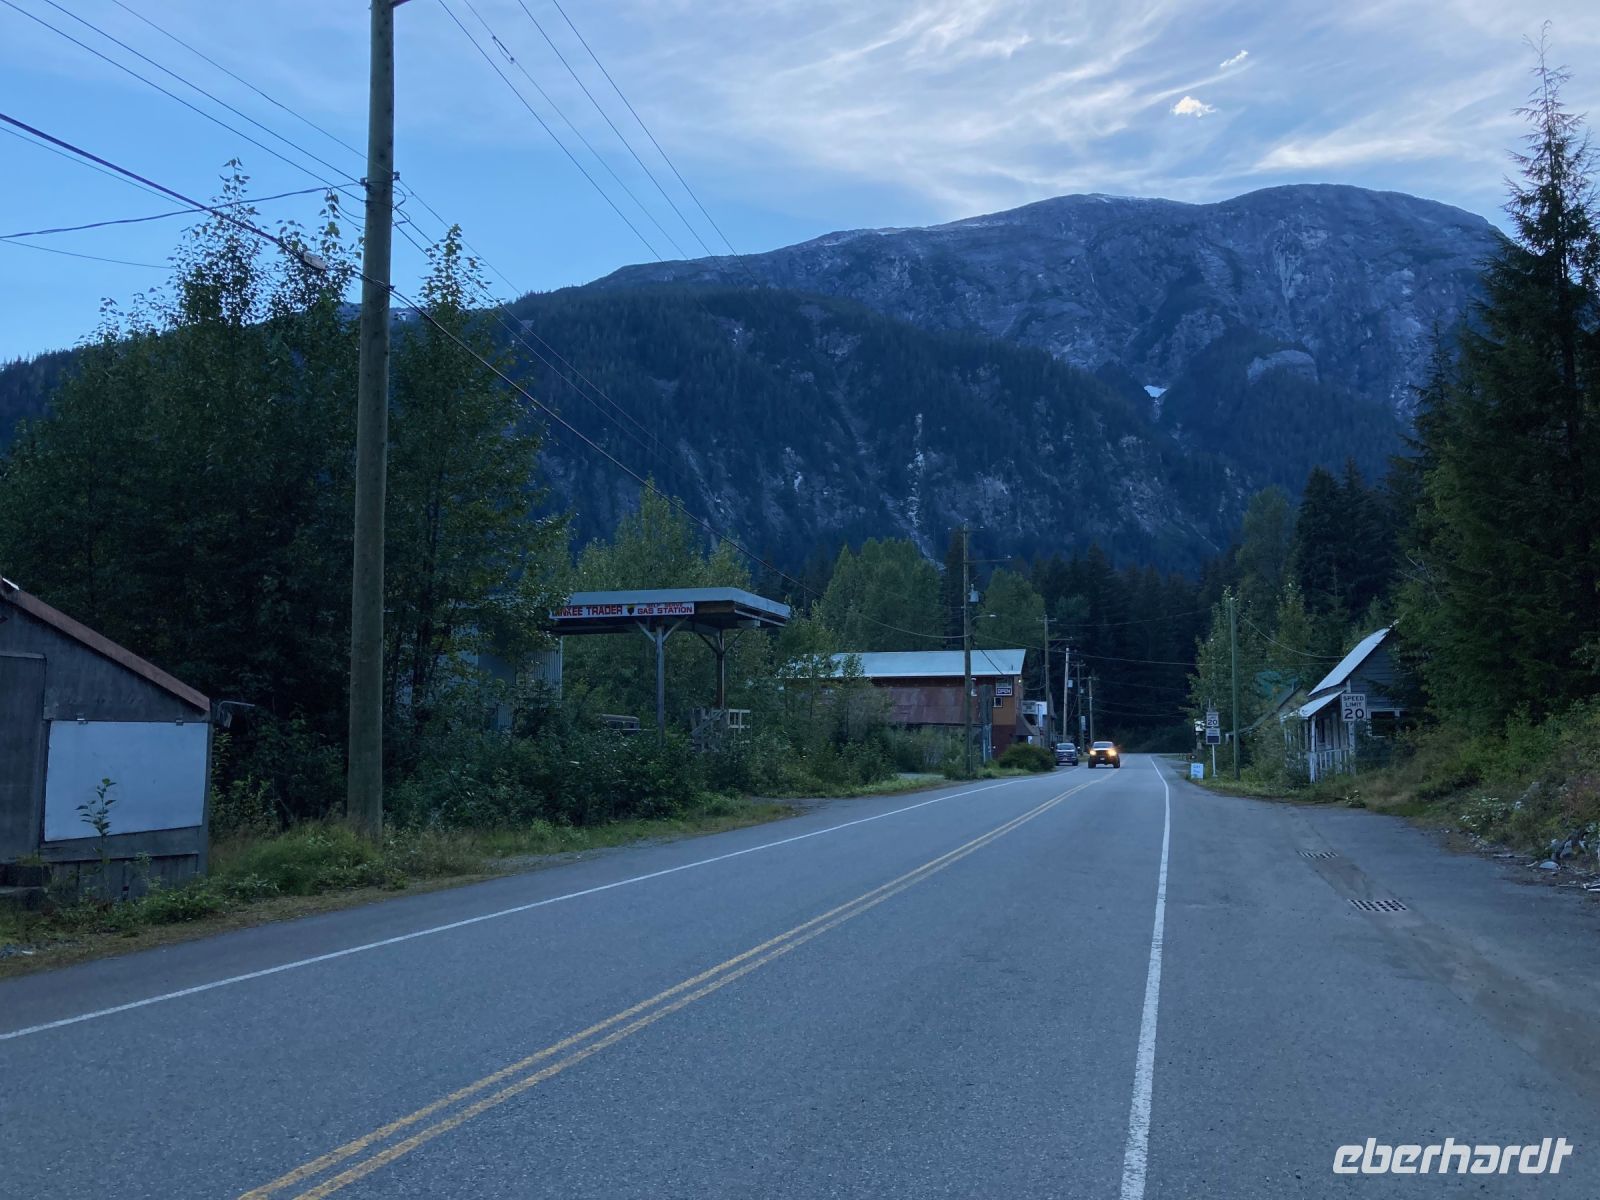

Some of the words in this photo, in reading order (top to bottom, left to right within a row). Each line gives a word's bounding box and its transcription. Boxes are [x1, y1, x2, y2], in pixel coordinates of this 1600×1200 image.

[552, 605, 583, 616] NKEE
[586, 604, 623, 616] TRADER
[637, 607, 654, 615] GAS
[657, 606, 693, 614] STATION
[1344, 708, 1364, 719] 20
